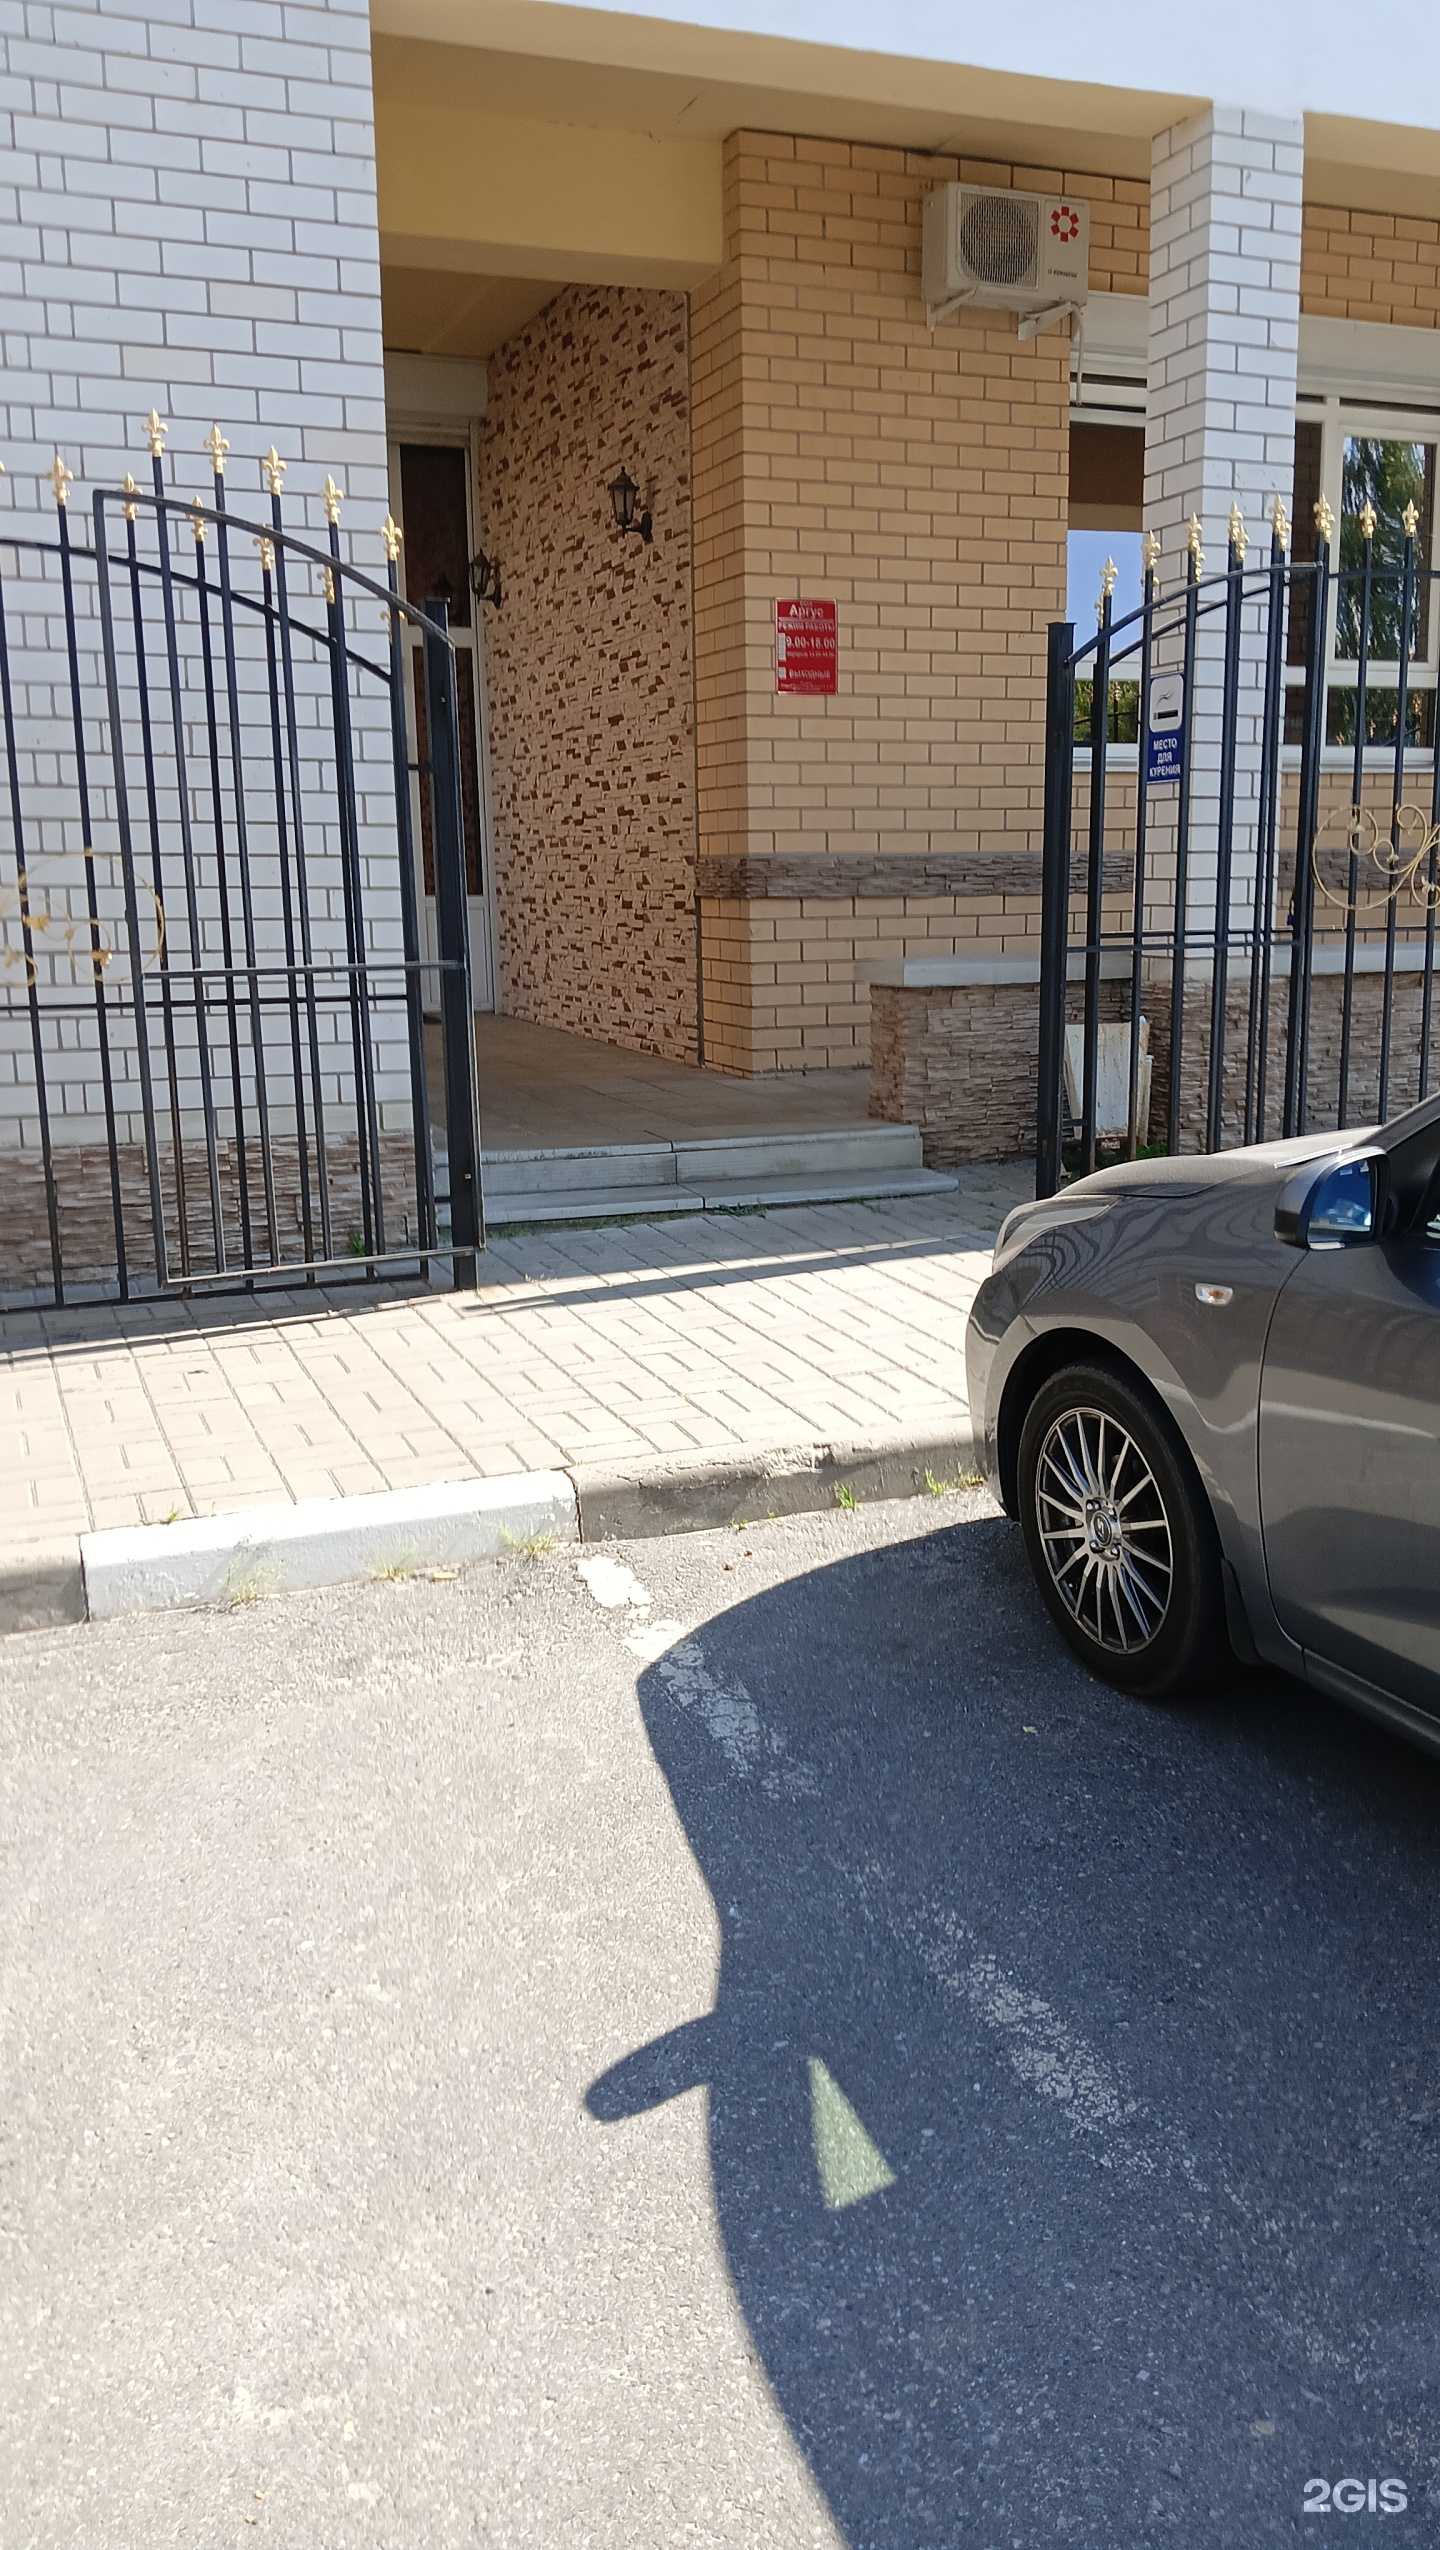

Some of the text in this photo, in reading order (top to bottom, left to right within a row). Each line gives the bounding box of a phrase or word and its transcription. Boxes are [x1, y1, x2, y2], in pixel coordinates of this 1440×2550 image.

[1153, 737, 1178, 750] МЕСТО
[1157, 752, 1173, 764] ДЛЯ
[1149, 764, 1181, 777] КУРЕНИЯ
